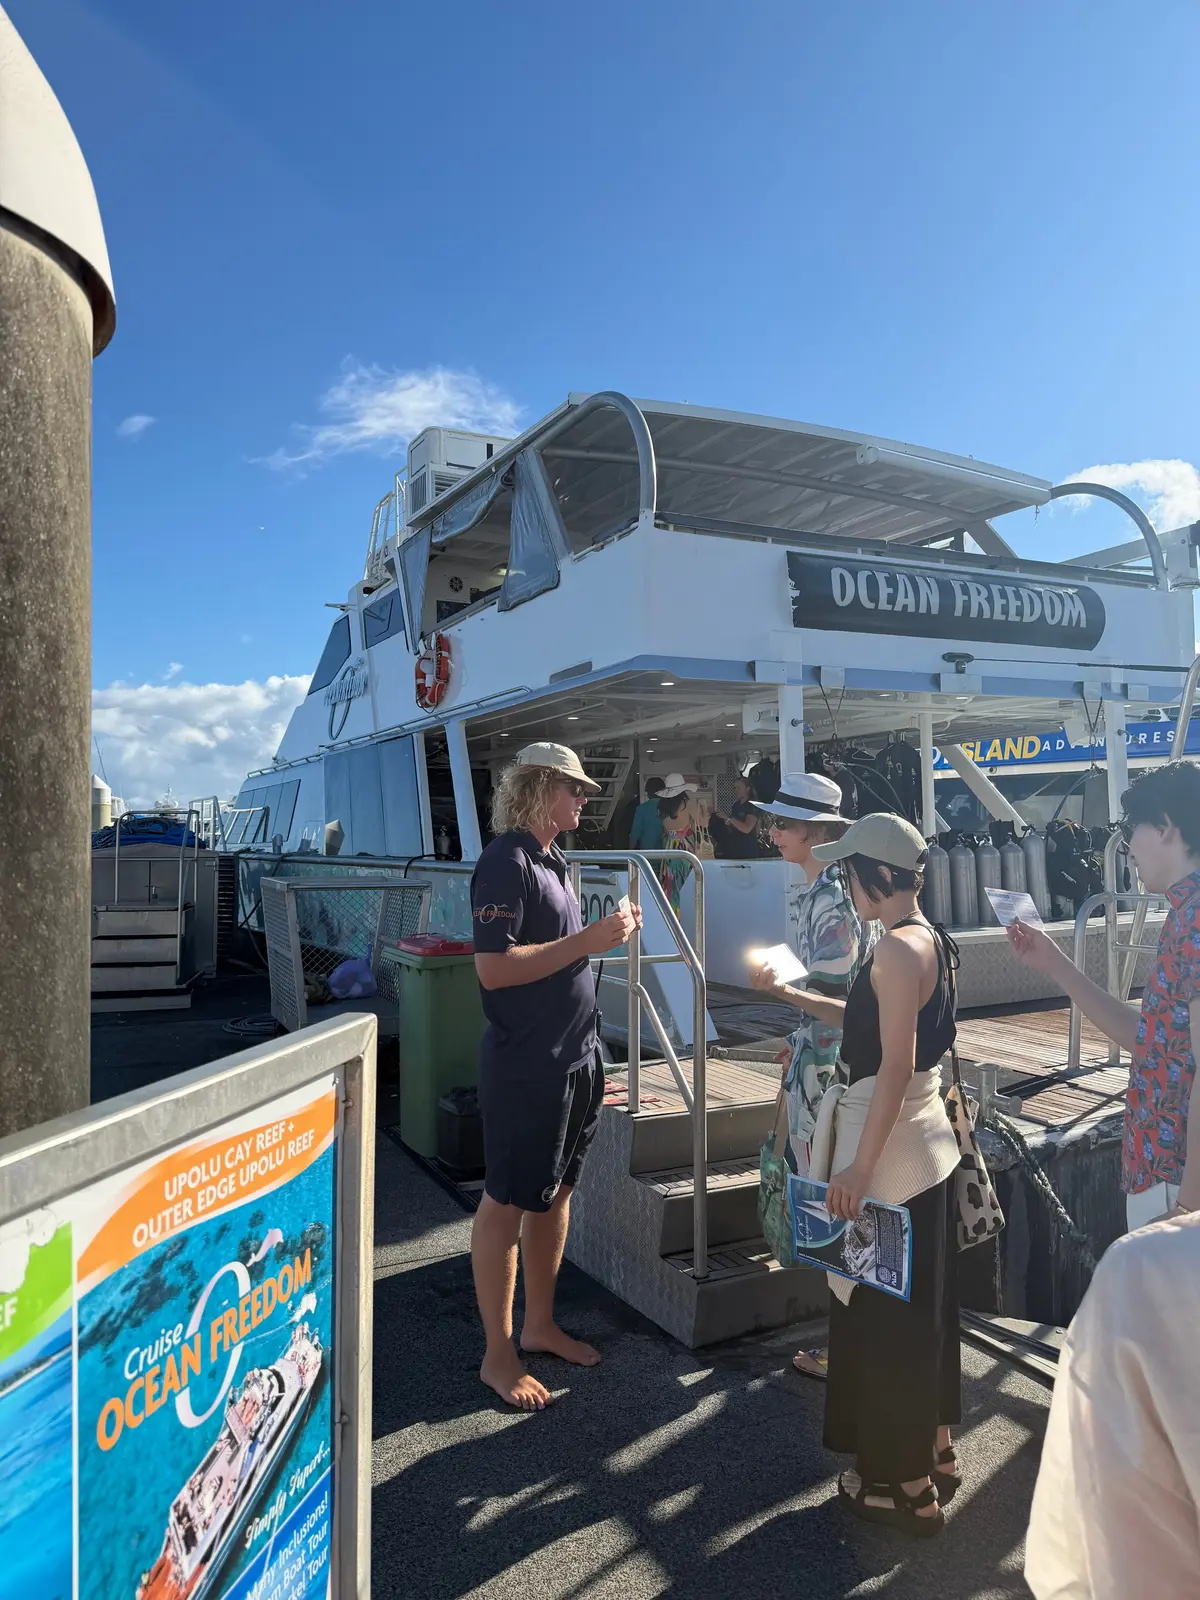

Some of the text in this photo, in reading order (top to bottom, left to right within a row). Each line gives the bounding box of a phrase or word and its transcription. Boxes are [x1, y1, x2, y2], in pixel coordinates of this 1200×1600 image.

[830, 566, 1087, 628] OCEAN FREEDOM
[961, 735, 1042, 762] SLAND
[132, 1129, 315, 1248] OUTER EDGE UPOLU REEF
[164, 1154, 221, 1201] UPOLU
[224, 1138, 253, 1169] CAY
[256, 1120, 286, 1151] REEF
[96, 1247, 312, 1451] OCEAN FREEDOM
[124, 1323, 184, 1380] Cruise
[279, 1490, 328, 1568] Inclusions!
[283, 1549, 306, 1590] Boat
[307, 1520, 328, 1555] Tour
[307, 1545, 328, 1580] Tour
